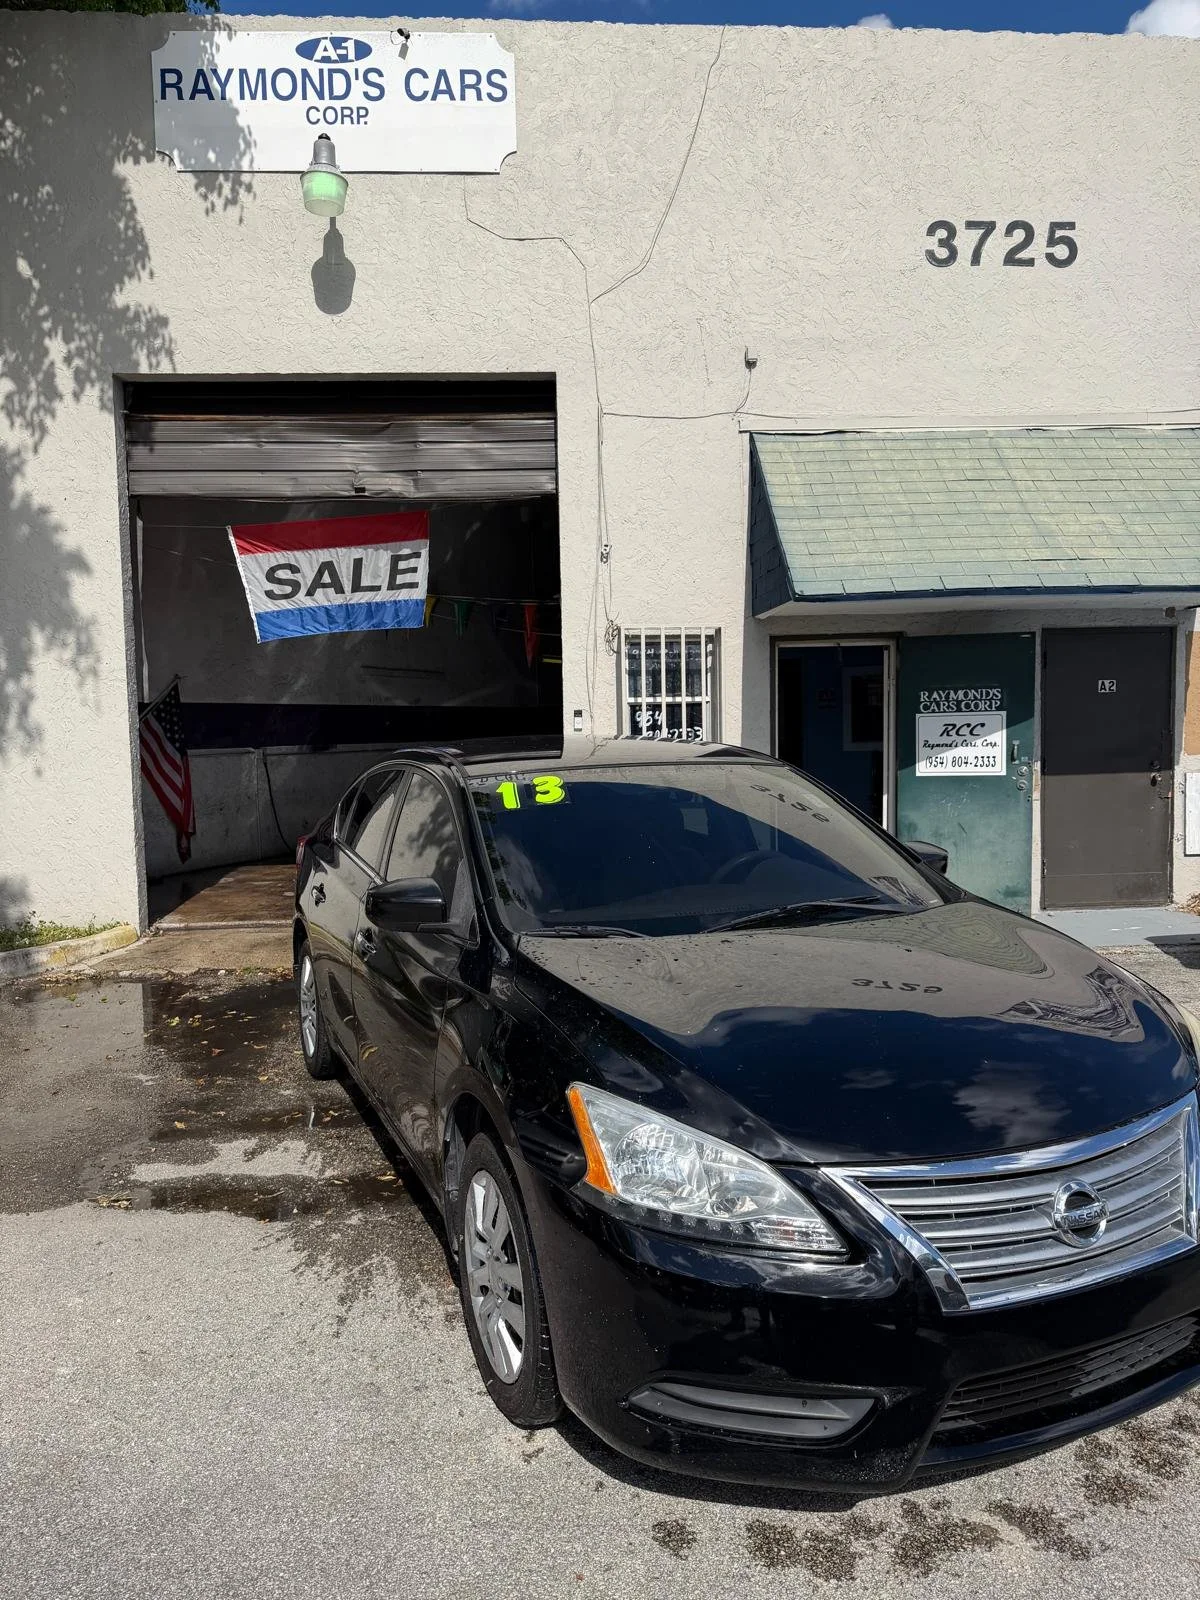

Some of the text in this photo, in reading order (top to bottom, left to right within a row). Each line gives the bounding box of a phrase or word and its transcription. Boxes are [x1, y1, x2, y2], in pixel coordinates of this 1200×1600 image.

[313, 38, 356, 62] A-1
[159, 67, 509, 103] RAYMOND'S CARS
[306, 105, 370, 125] CORP.
[924, 219, 1079, 269] 3725
[264, 551, 422, 601] SALE
[920, 688, 1002, 702] RAYMOND'S
[1099, 680, 1115, 692] A2
[920, 699, 1001, 713] CARS CORP
[939, 722, 986, 737] RCC
[925, 756, 997, 769] (954) 804-2333
[1061, 1203, 1108, 1228] NISSAN
